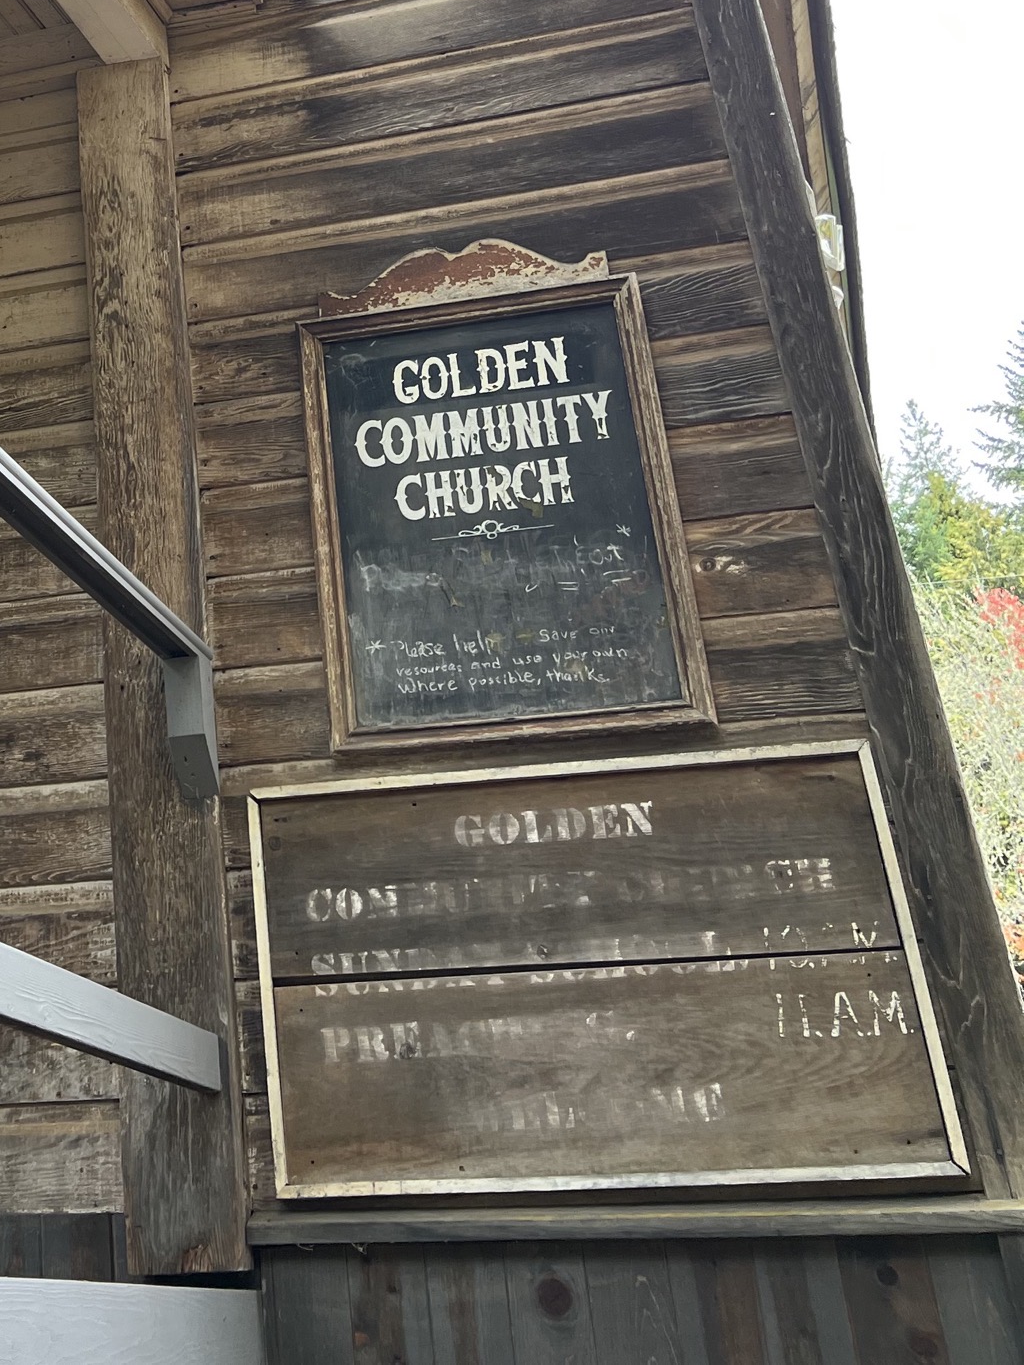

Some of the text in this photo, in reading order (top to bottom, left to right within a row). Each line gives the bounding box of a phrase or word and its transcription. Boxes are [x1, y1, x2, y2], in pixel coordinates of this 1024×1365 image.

[392, 336, 569, 405] GOLDEN
[353, 389, 613, 468] COMMUNITY
[394, 456, 575, 521] CHURCH
[454, 801, 655, 848] GOLDEN
